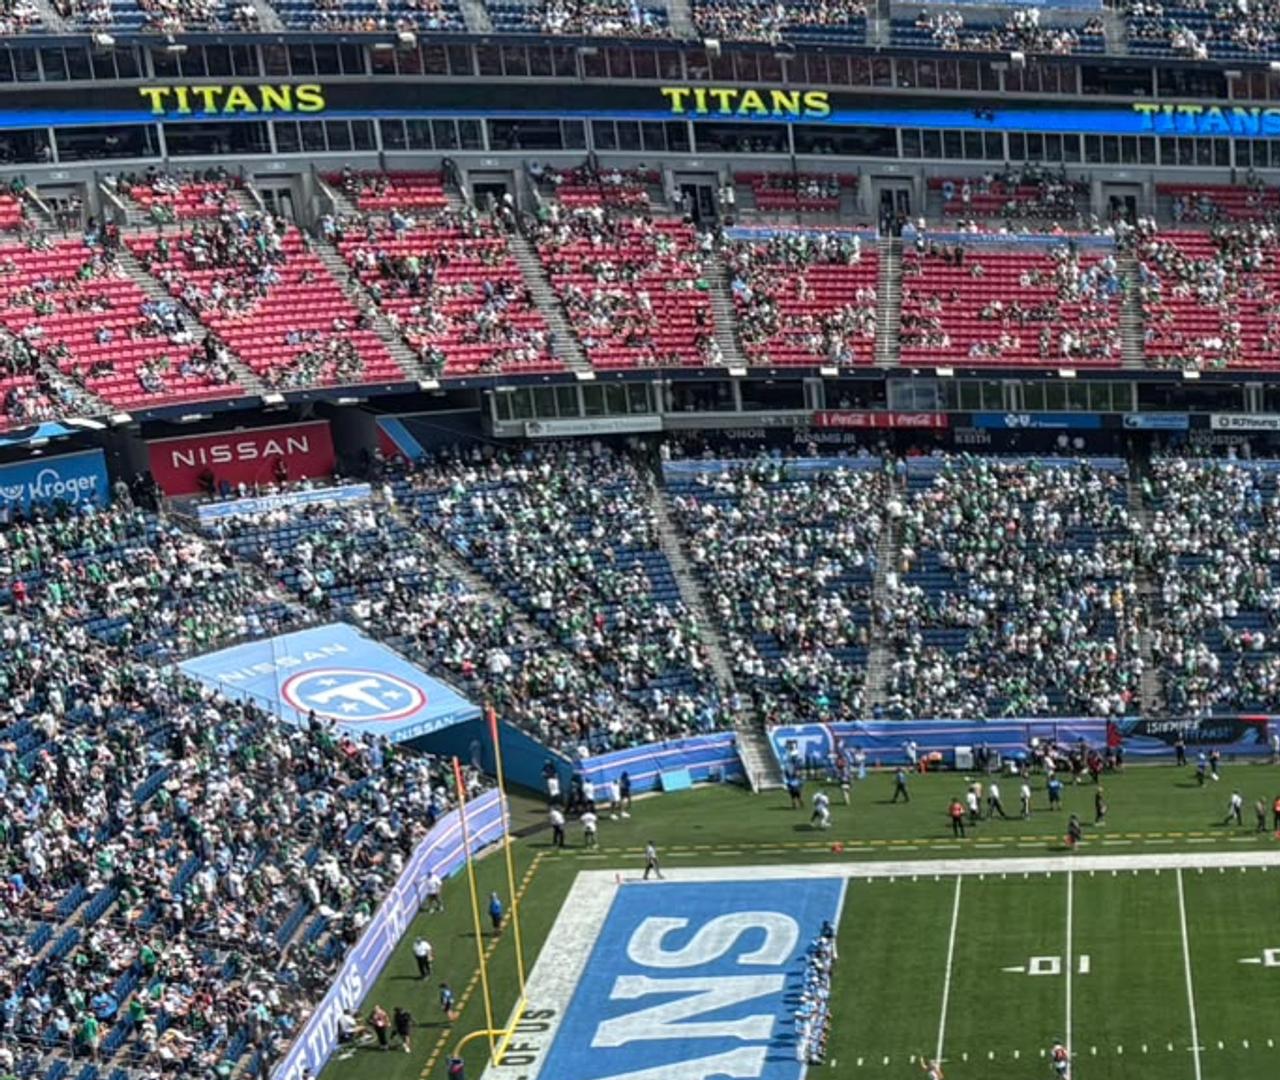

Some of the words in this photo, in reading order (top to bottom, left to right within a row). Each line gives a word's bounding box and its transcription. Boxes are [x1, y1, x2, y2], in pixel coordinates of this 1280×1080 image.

[141, 84, 325, 114] TITANS
[662, 87, 828, 118] TITANS
[172, 436, 309, 467] NISSAN
[29, 469, 97, 503] Kroger
[219, 644, 347, 682] NISSAN
[396, 714, 455, 740] NISSAN
[308, 962, 367, 1067] TITANS
